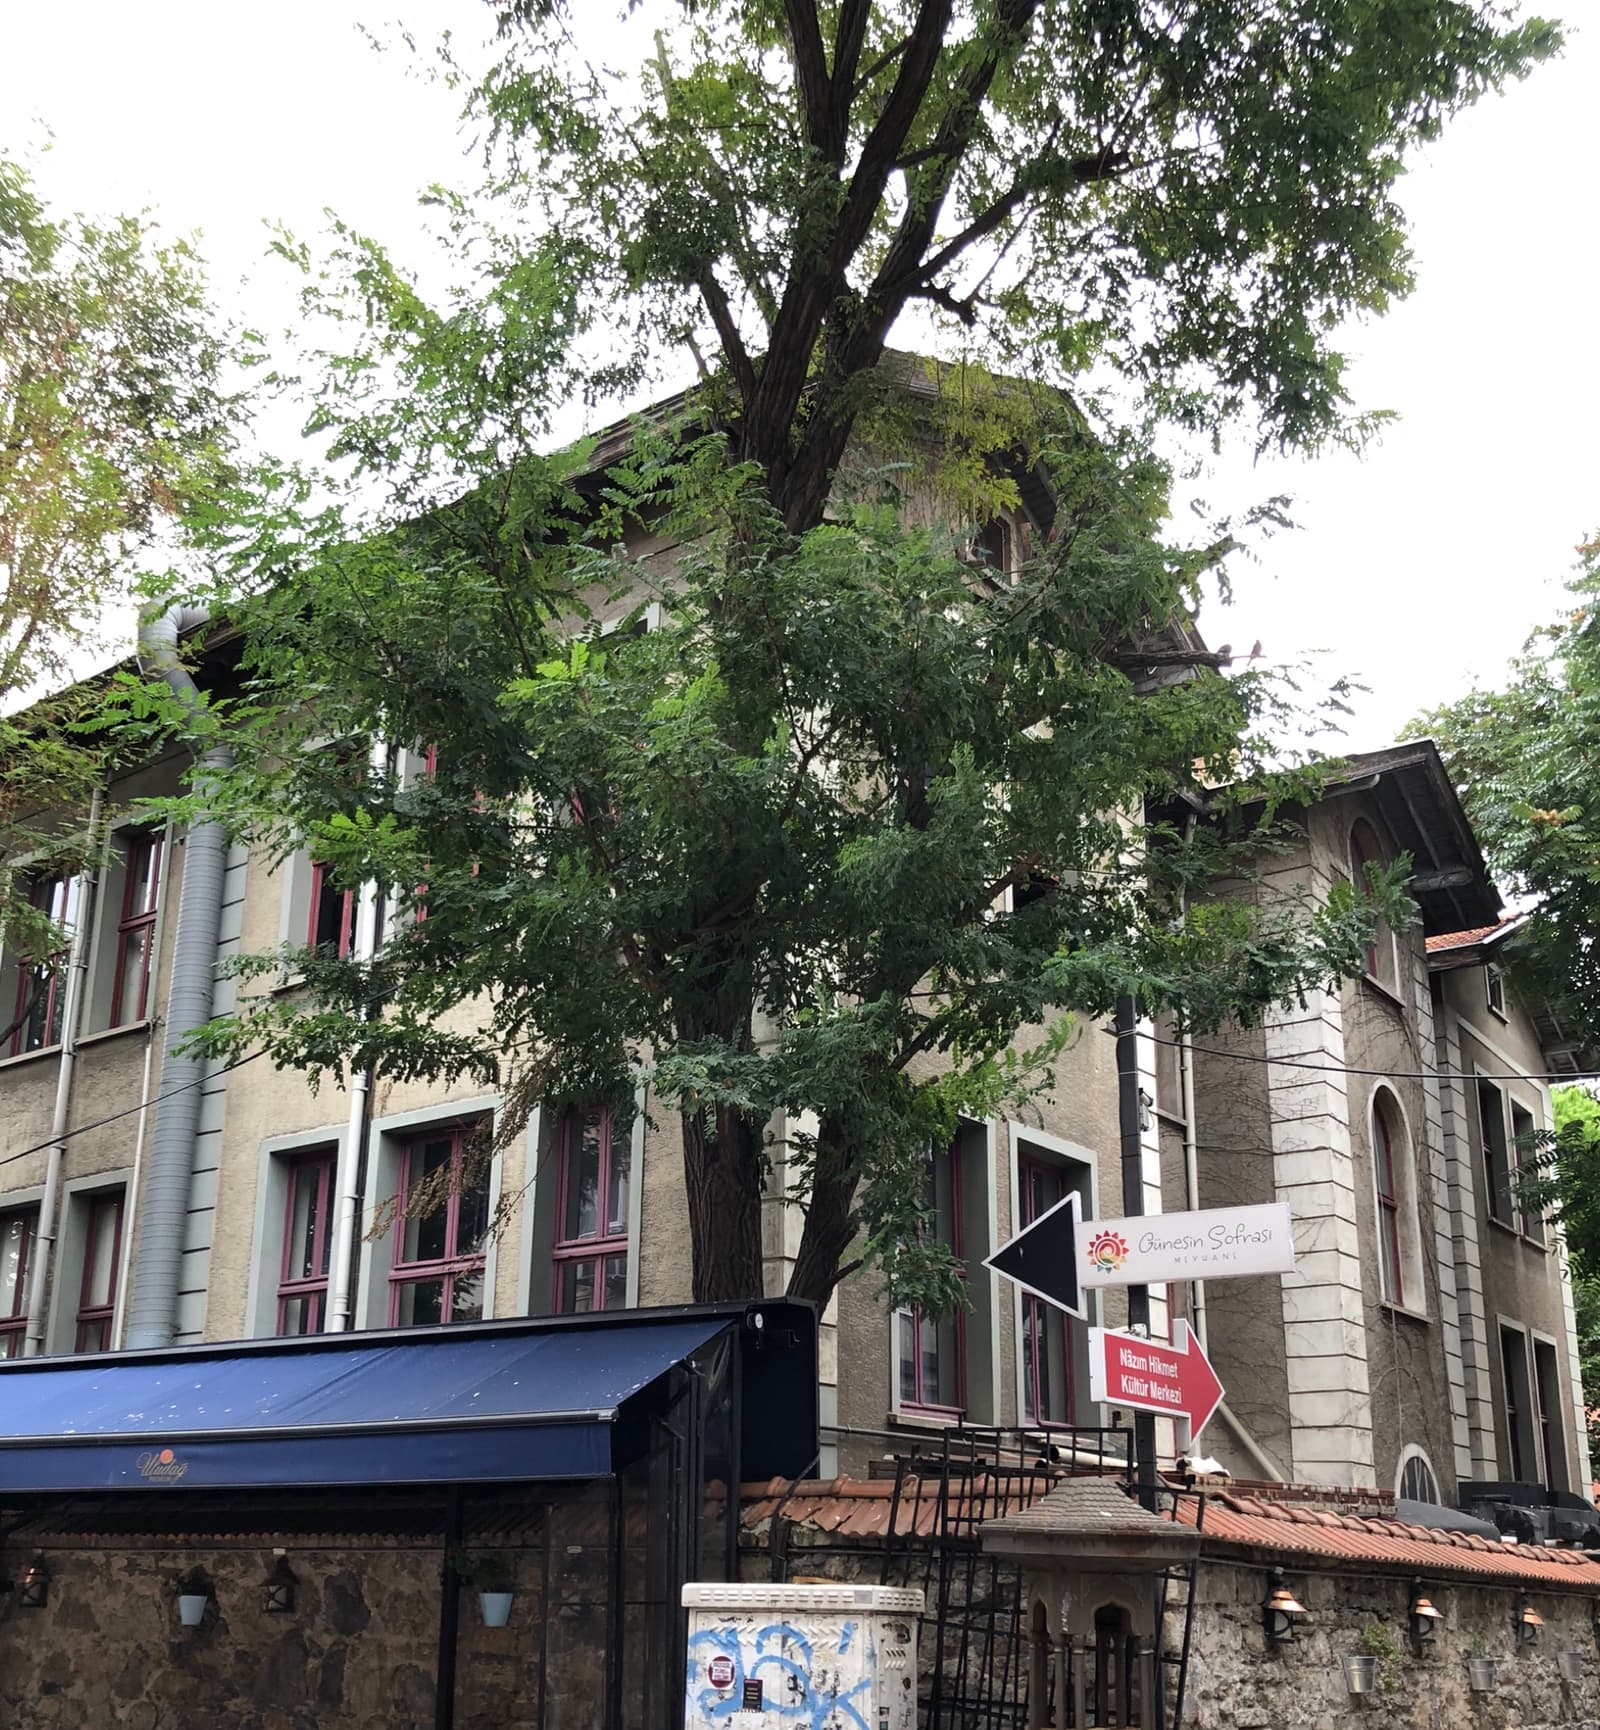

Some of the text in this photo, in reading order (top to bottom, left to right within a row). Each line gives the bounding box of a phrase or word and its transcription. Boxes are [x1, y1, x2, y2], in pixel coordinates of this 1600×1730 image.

[1208, 1223, 1272, 1250] Sofrası
[1120, 1347, 1178, 1379] Nâzım Hikmet
[1121, 1374, 1182, 1404] Kültür Merkezi
